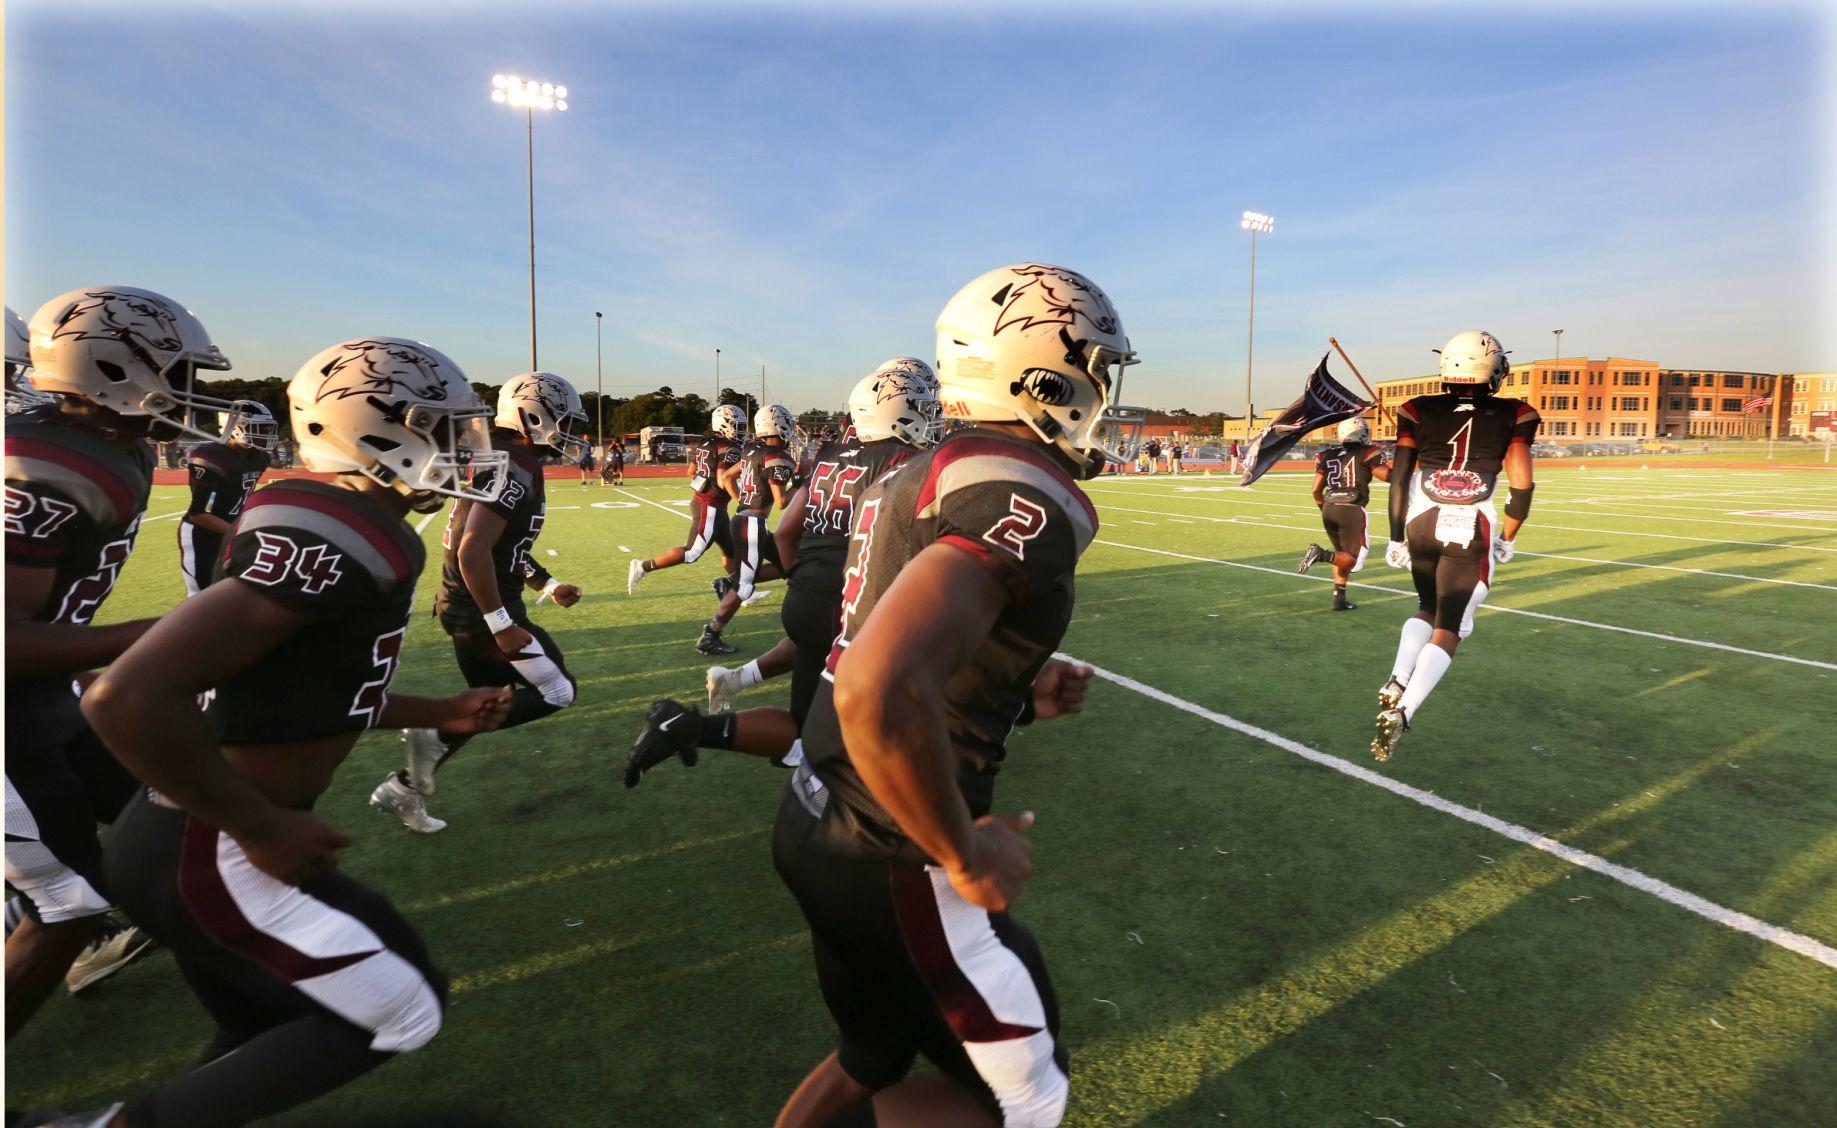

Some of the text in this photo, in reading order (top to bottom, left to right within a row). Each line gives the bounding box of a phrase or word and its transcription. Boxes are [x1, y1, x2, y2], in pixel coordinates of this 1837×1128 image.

[1443, 376, 1476, 384] Riddell
[1447, 417, 1473, 471] 1
[194, 466, 206, 480] 7
[1326, 456, 1356, 489] 21
[1424, 480, 1451, 496] PLAY
[1461, 484, 1489, 497] GAME
[1470, 472, 1482, 485] TO
[5, 485, 78, 538] 27
[228, 479, 257, 515] 7
[803, 461, 868, 537] 56
[982, 492, 1047, 561] 2
[239, 531, 343, 594] 34
